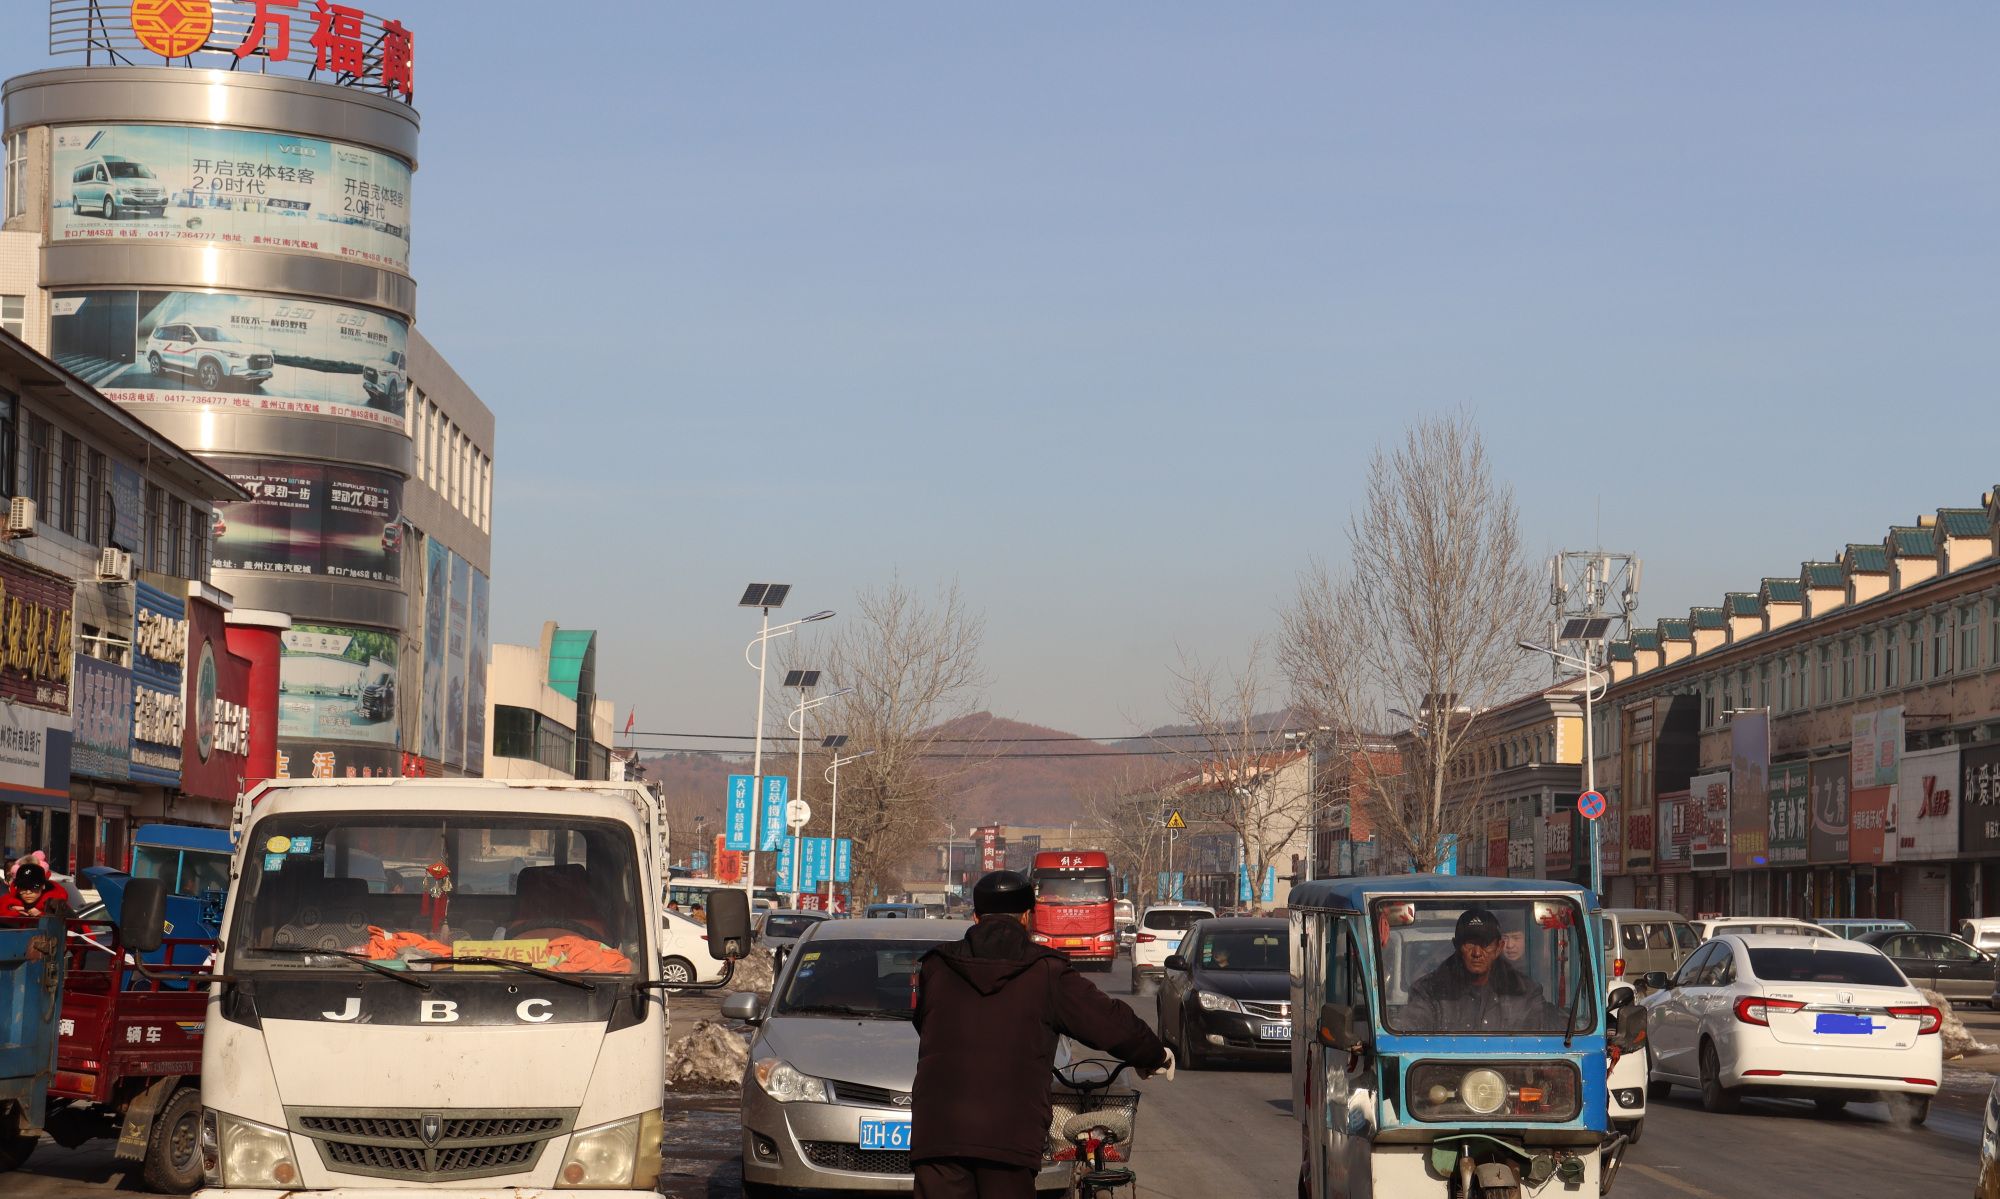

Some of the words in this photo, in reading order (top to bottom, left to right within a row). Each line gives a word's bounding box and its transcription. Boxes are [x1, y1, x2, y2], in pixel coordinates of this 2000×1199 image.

[193, 158, 315, 185] 开启宽体轻客
[192, 176, 265, 195] 2.0时代
[344, 177, 404, 208] 开启宽体轻客
[147, 230, 216, 240] 0417-7364777
[243, 561, 312, 575] 盖州辽南汽配城
